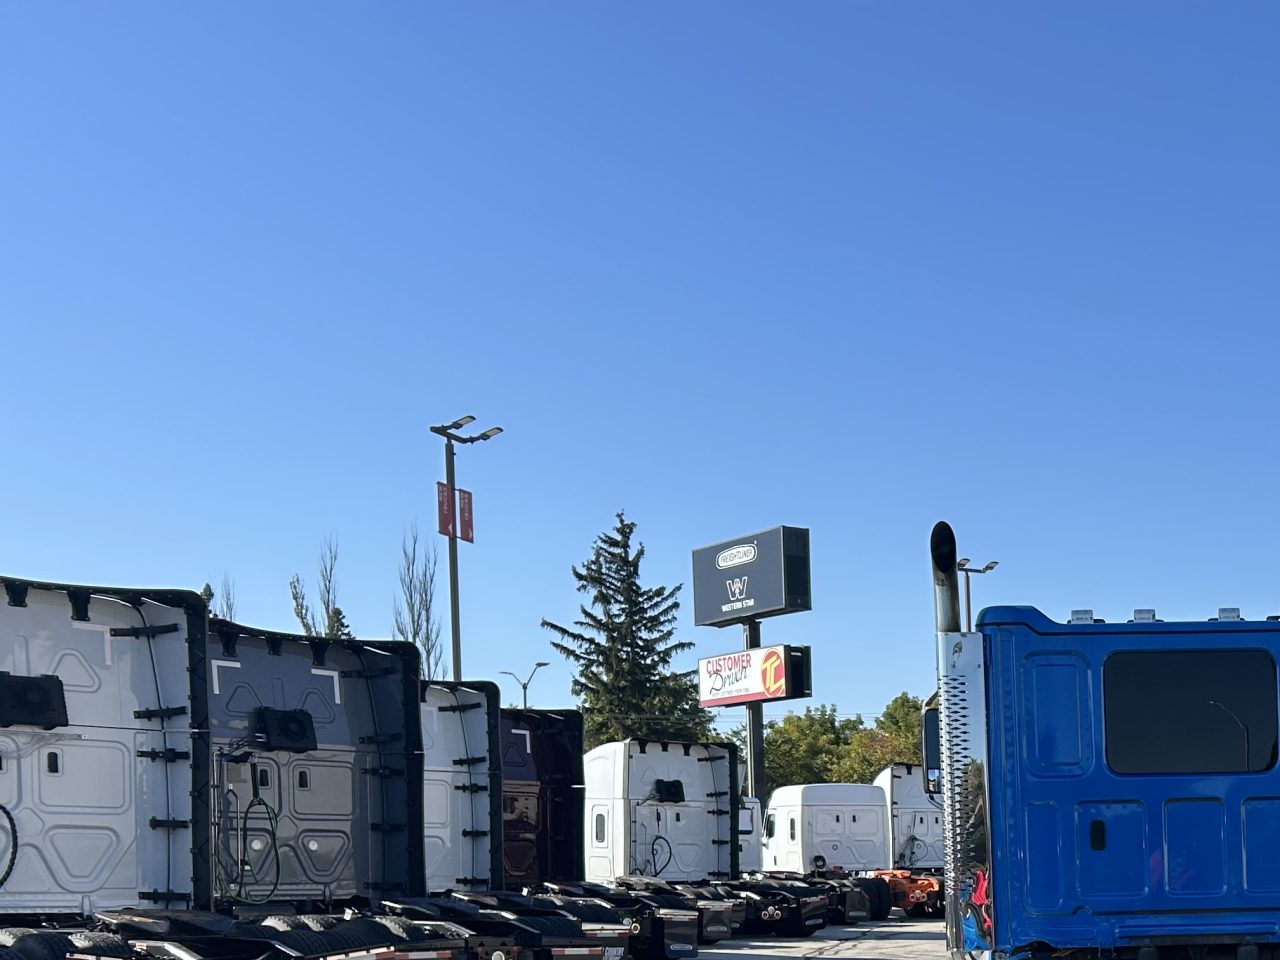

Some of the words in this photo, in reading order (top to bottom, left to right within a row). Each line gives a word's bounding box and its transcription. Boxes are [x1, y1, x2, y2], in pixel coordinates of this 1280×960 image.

[720, 548, 753, 565] FREIGHTLINER
[721, 601, 742, 612] WESTERN
[743, 598, 754, 608] STAR
[706, 653, 751, 675] CUSTOMER
